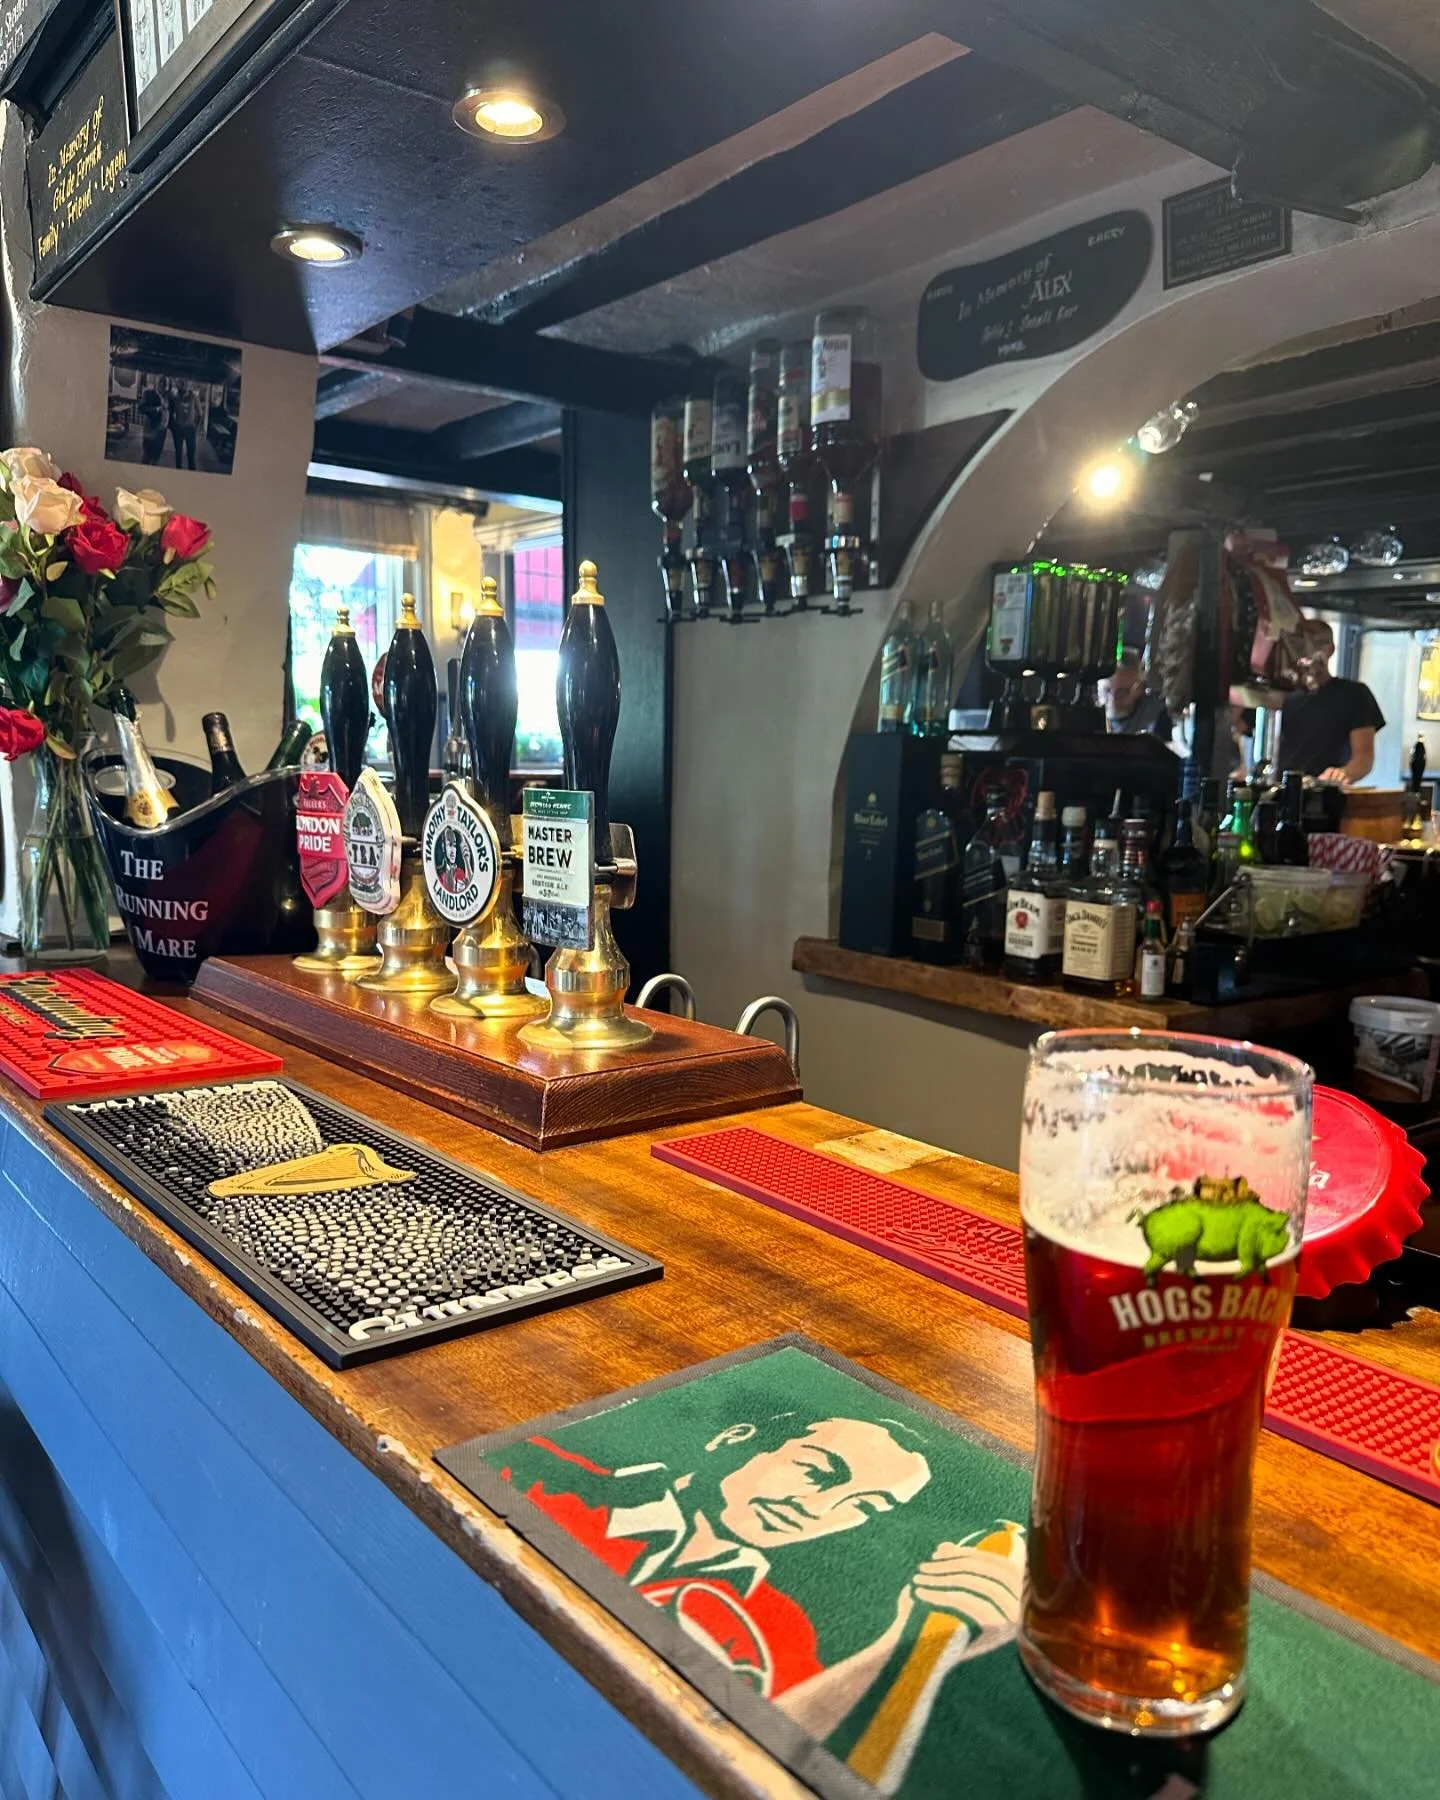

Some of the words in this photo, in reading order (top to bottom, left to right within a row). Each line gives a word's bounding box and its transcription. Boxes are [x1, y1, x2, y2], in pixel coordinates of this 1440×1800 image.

[67, 186, 93, 226] Friend
[299, 834, 332, 852] PRIDE
[425, 805, 446, 863] TIMOTHY
[457, 805, 488, 873] TAYLOR'S
[528, 825, 572, 843] MASTER
[120, 850, 164, 880] THE
[528, 845, 573, 868] BREW
[115, 885, 209, 921] RUNNING
[433, 880, 479, 911] LANDLORD
[133, 925, 197, 958] MARE
[349, 1256, 632, 1340] GUINNESS
[1109, 1284, 1213, 1331] HOGS
